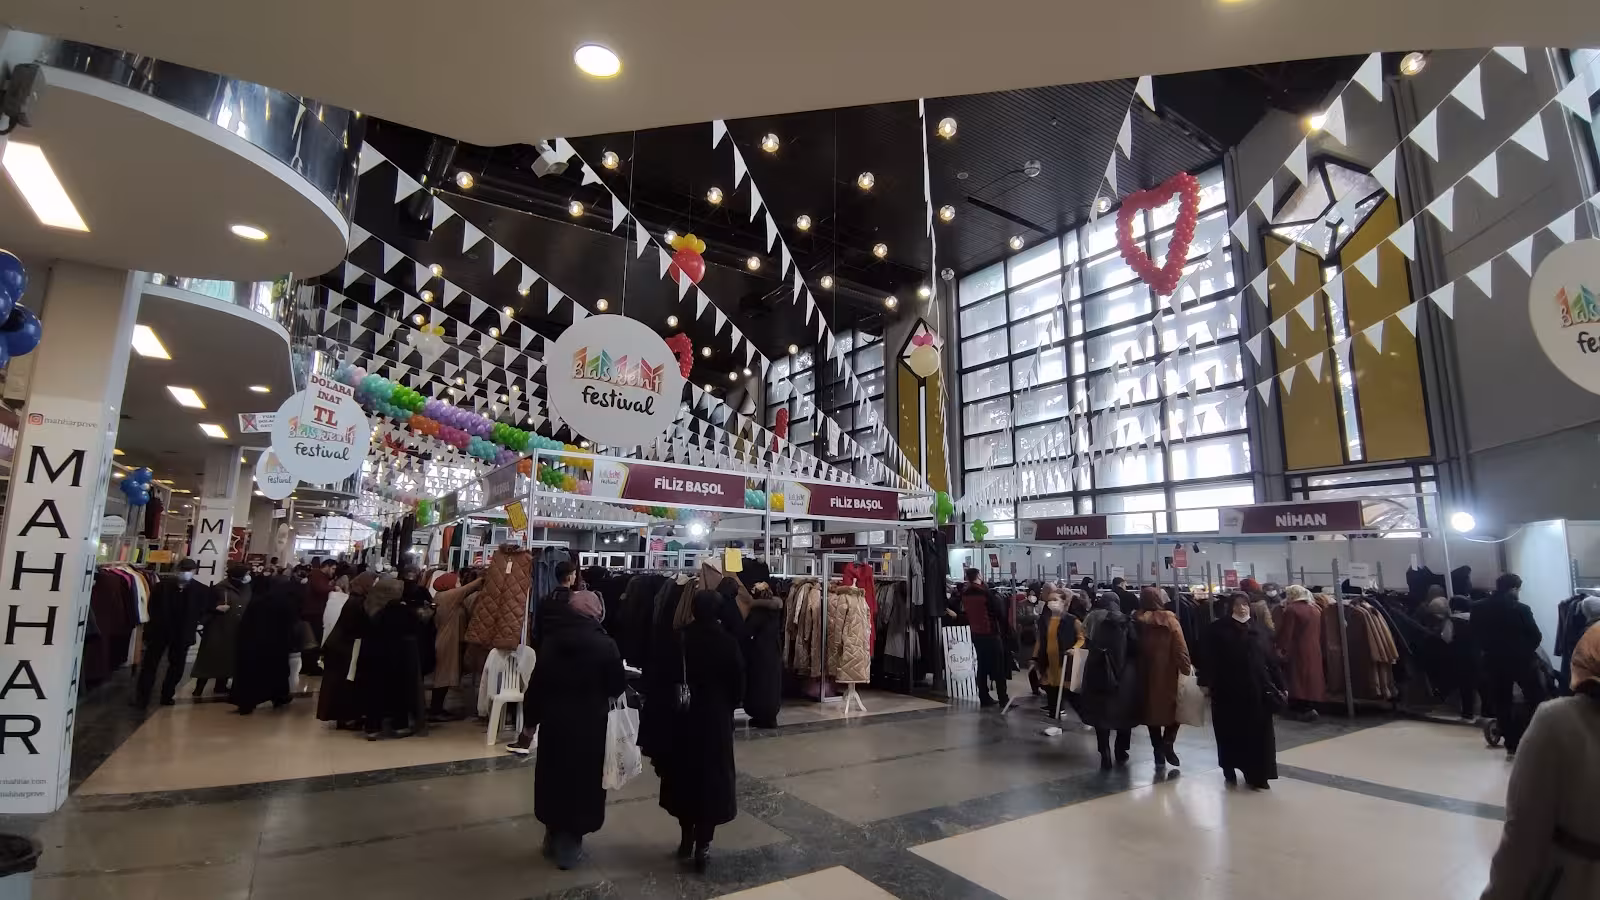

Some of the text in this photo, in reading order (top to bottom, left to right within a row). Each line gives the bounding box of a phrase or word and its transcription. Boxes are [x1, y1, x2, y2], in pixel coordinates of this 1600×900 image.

[310, 375, 352, 397] DOLARA
[317, 388, 342, 405] İNAT
[581, 385, 655, 415] festival
[313, 405, 338, 427] TL
[294, 442, 350, 460] festival
[654, 476, 725, 497] FİLİZ BAŞOL
[830, 496, 883, 511] FİLİZ BAŞOL
[1274, 512, 1327, 527] NİHAN
[1056, 523, 1088, 536] NİHAN
